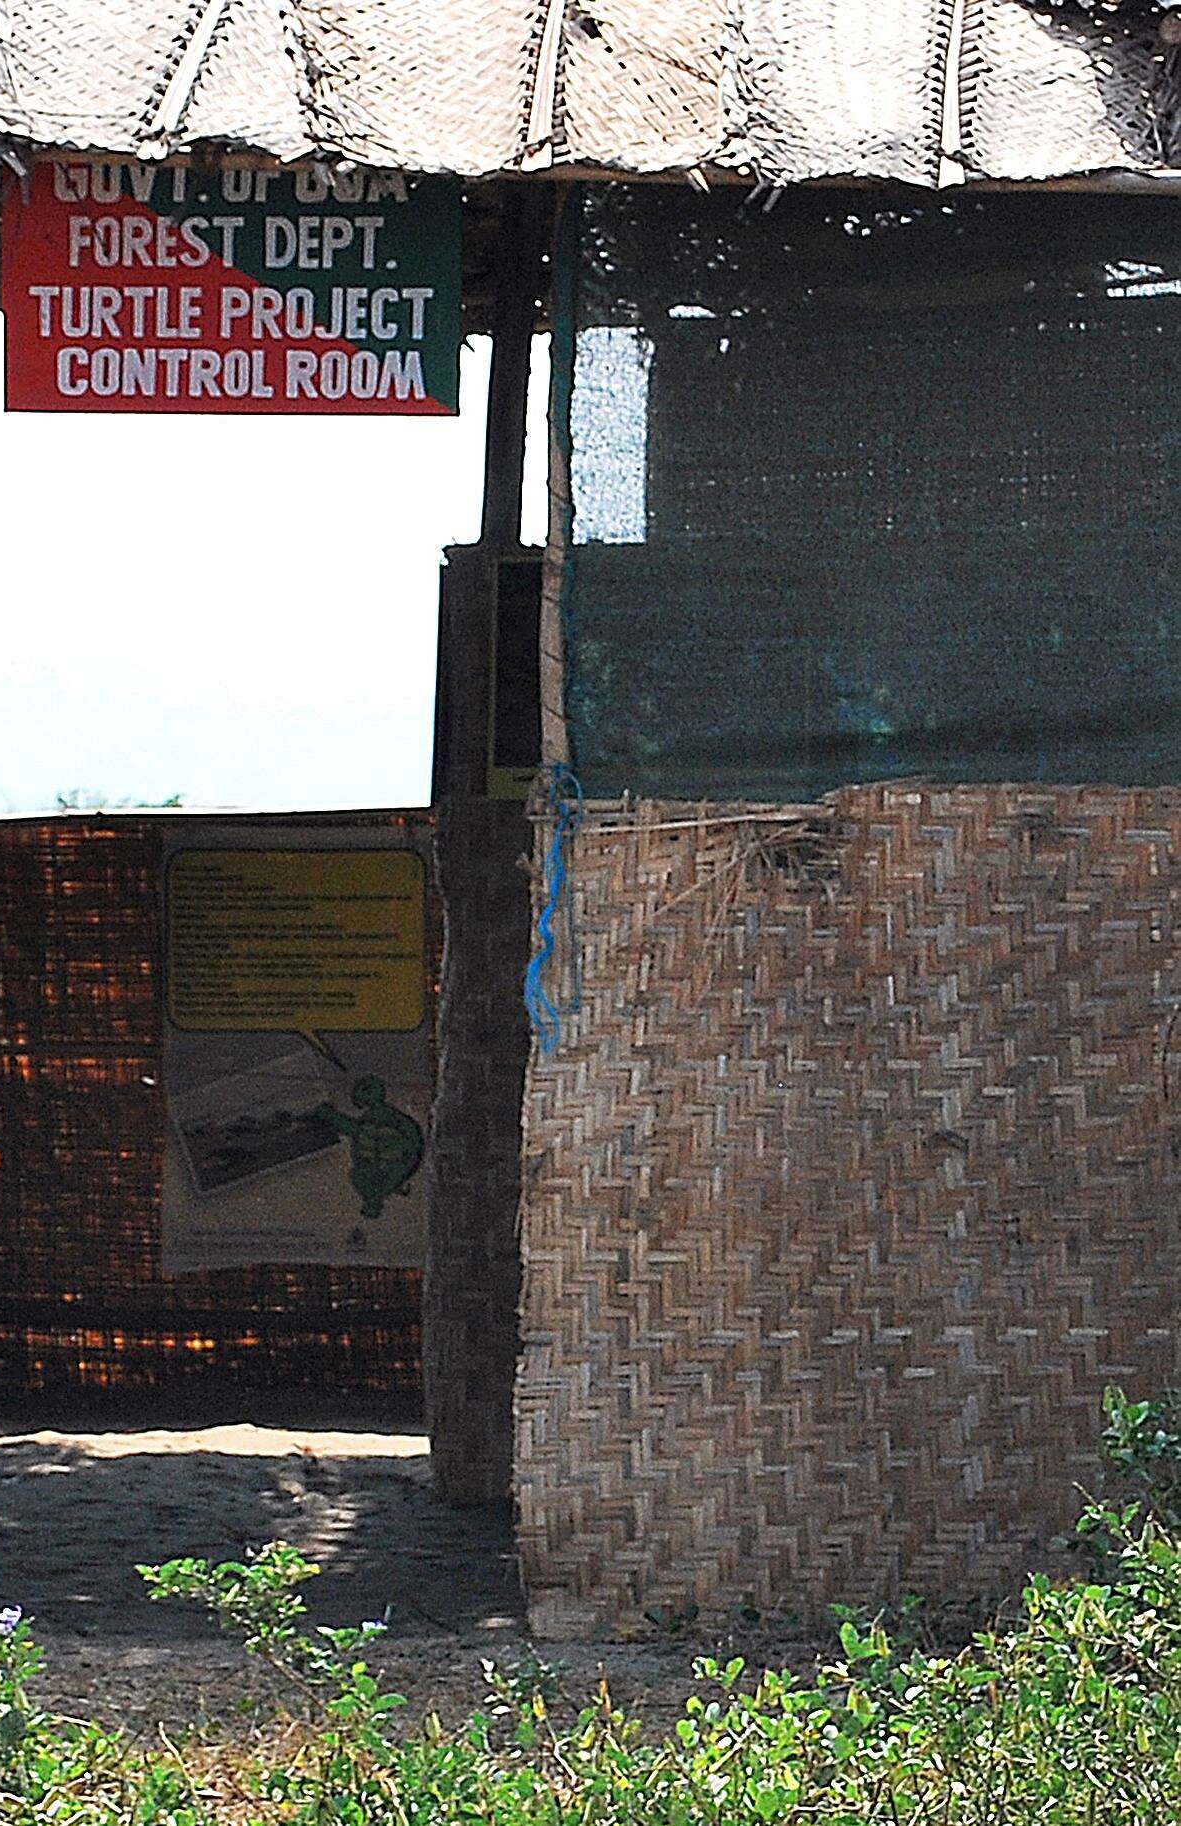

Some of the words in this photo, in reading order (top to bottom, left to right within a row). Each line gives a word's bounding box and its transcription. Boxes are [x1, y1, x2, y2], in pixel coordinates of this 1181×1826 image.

[68, 215, 245, 269] FOREST
[265, 216, 398, 270] DEPT.
[29, 286, 203, 338] TURTLE
[220, 287, 434, 340] PROJECT
[56, 346, 274, 398] CONTROL
[285, 350, 426, 400] ROOM
